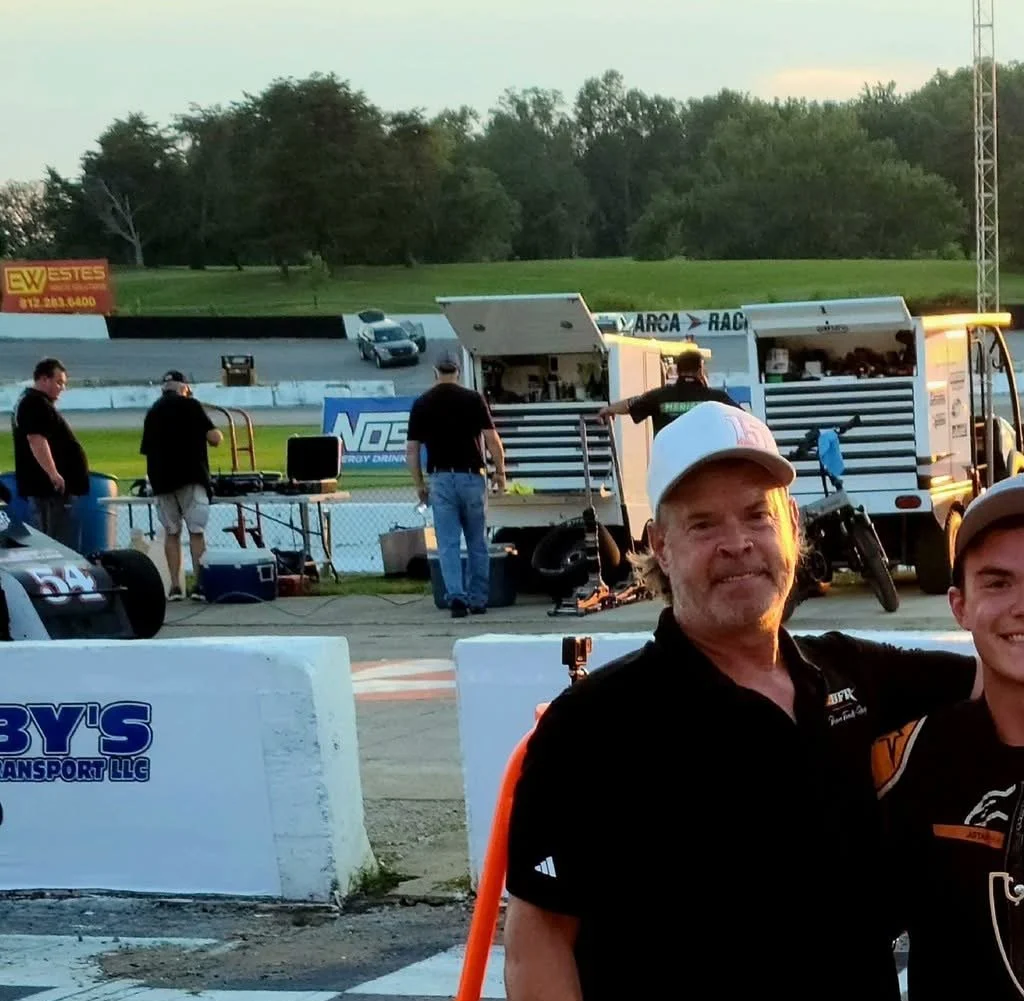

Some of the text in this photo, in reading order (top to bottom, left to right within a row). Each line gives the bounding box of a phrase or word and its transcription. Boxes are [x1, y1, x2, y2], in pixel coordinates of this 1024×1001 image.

[47, 266, 106, 281] ESTES
[634, 312, 681, 333] ARCA
[332, 411, 411, 452] NOS
[342, 454, 370, 463] ERGY
[0, 701, 153, 757] BY'S
[0, 756, 151, 783] ANSPORT LLC
